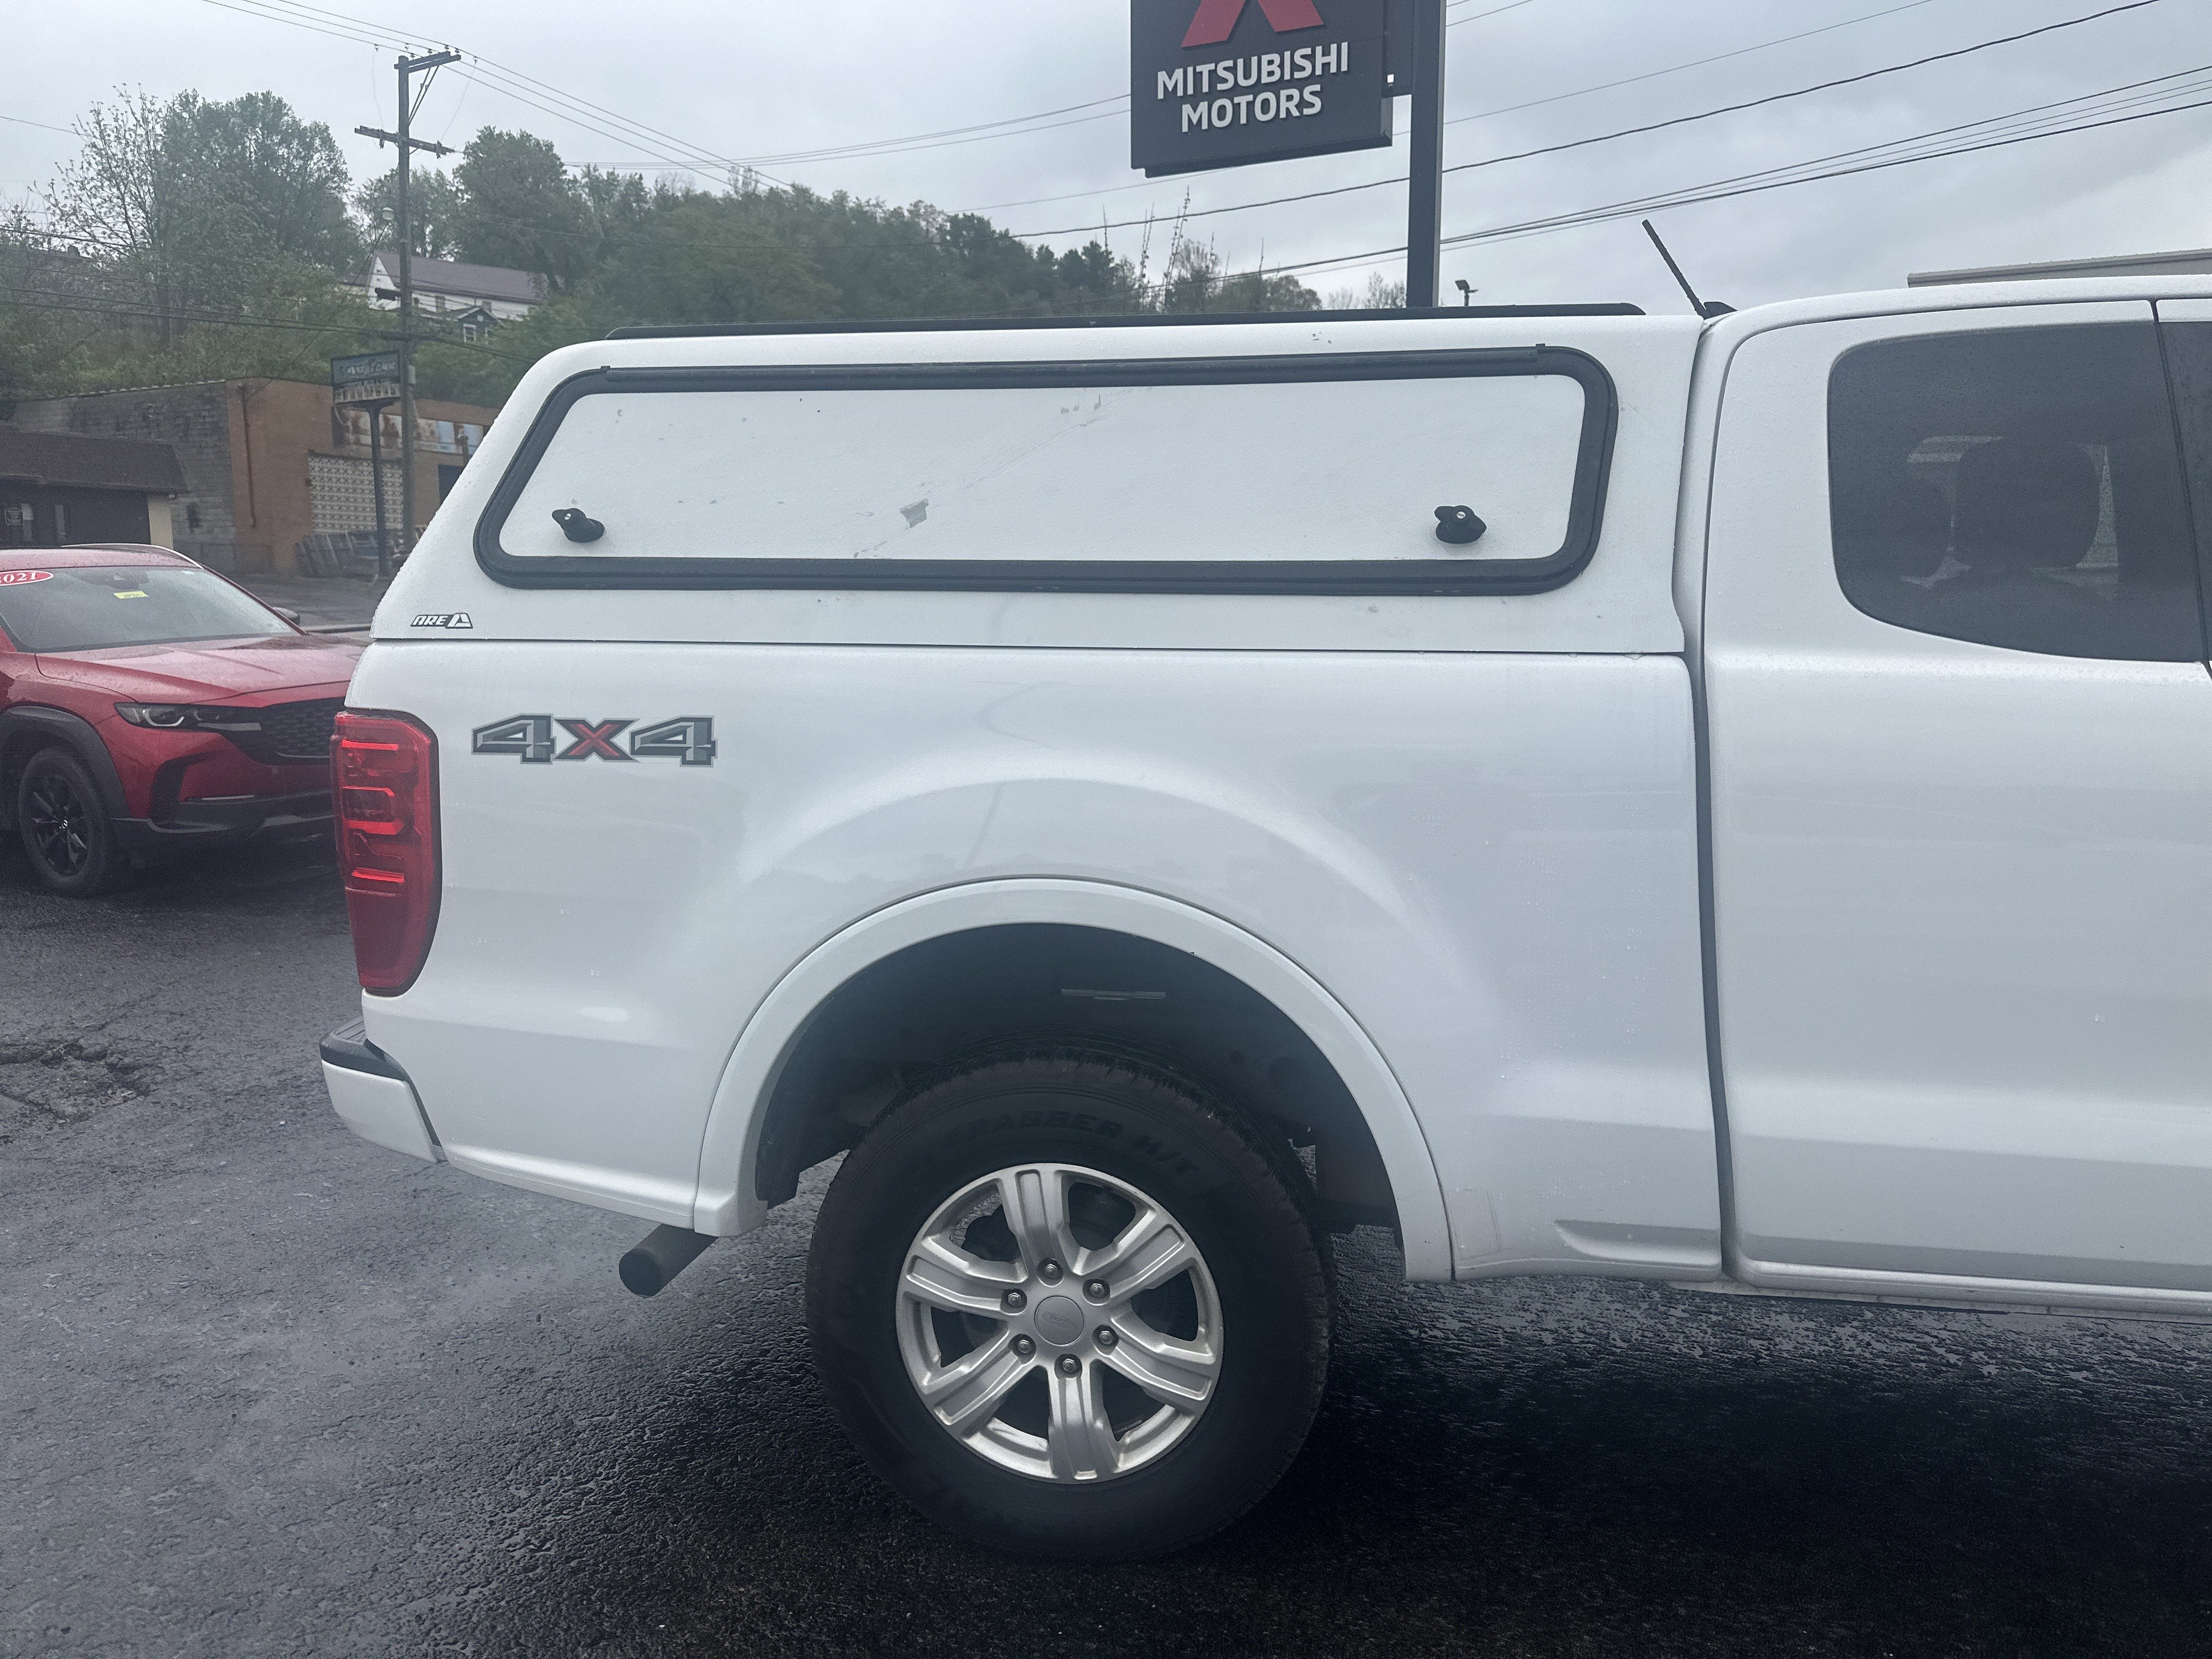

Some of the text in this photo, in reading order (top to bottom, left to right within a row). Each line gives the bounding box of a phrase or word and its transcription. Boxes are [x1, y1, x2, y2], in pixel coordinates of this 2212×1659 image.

[1157, 41, 1348, 100] MITSUBISHI
[1181, 84, 1322, 133] MOTORS
[0, 572, 36, 583] 021
[411, 615, 449, 626] ARE
